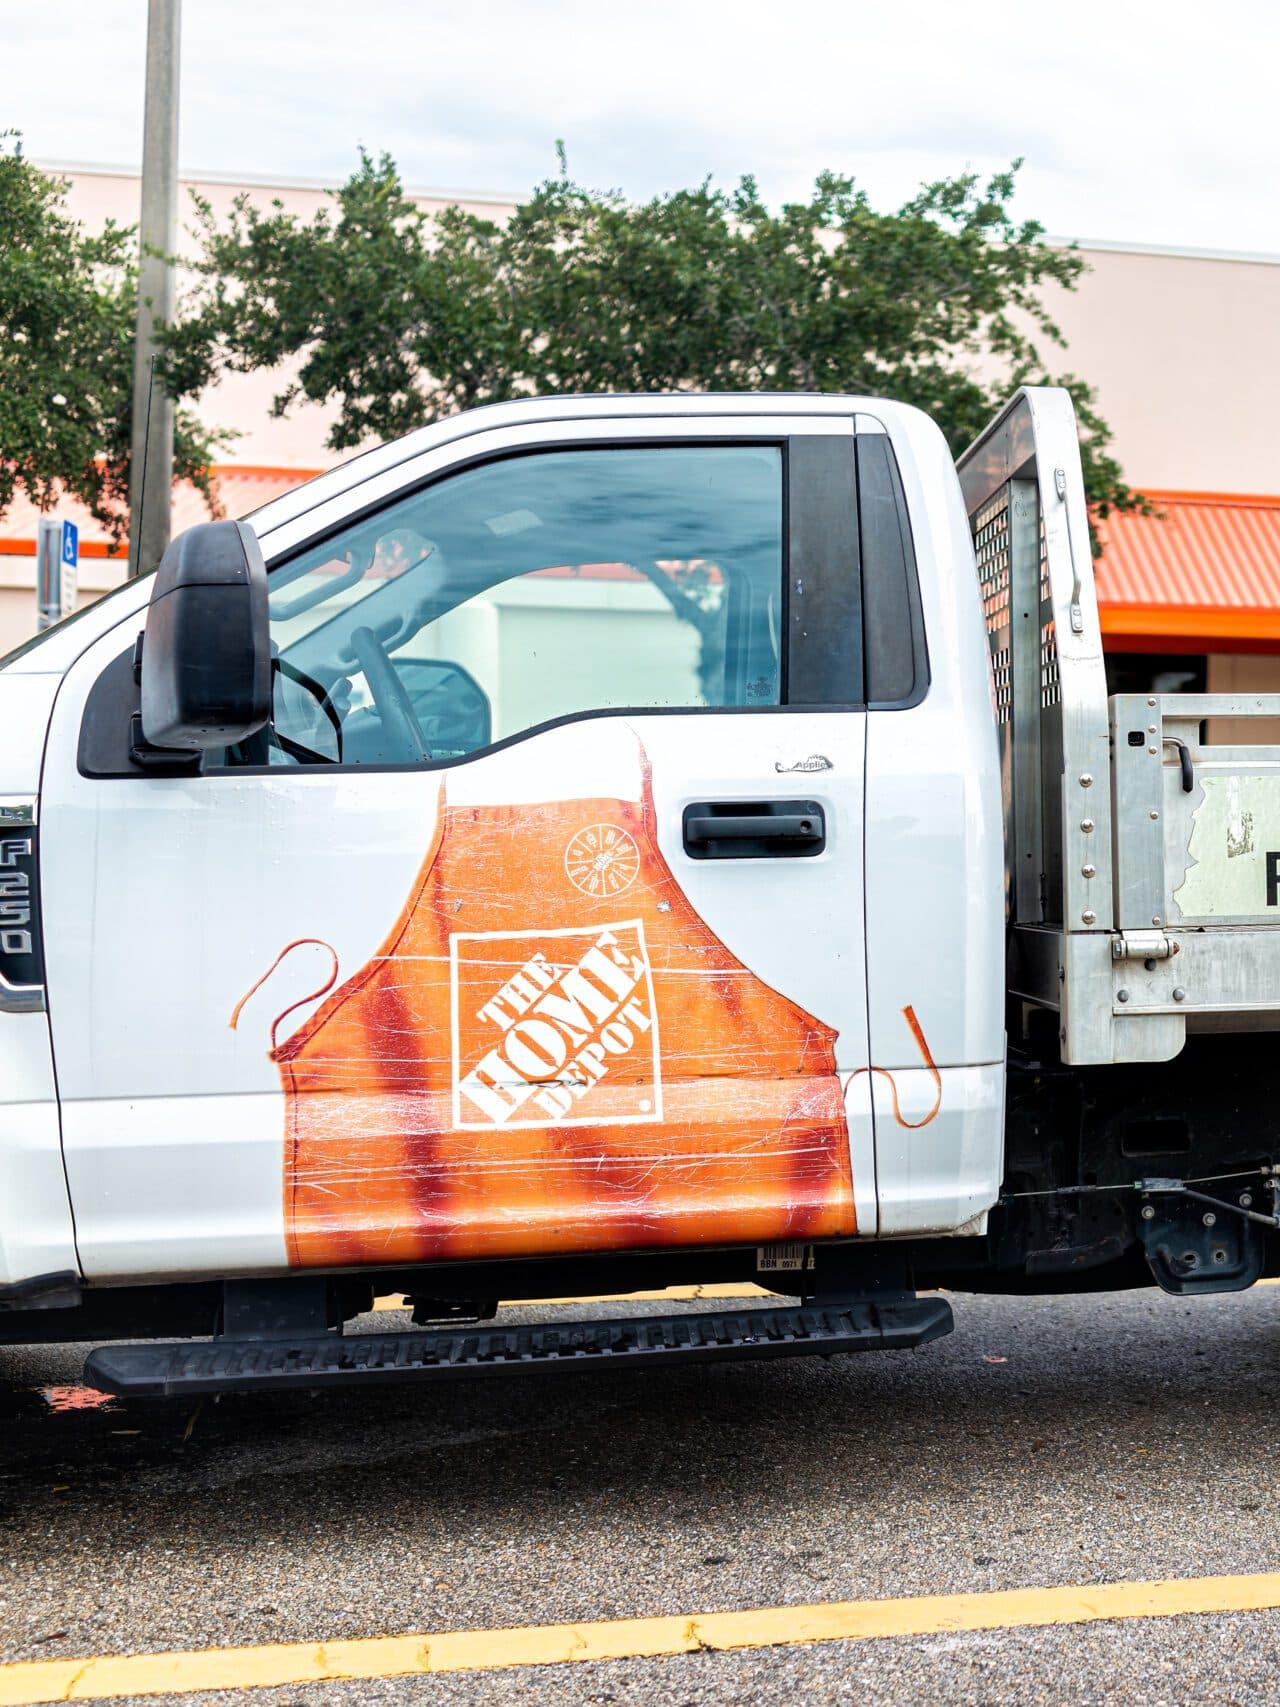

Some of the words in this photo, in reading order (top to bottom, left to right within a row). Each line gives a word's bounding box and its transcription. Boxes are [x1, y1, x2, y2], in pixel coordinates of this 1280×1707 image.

[459, 930, 647, 1122] HOME
[475, 952, 563, 1032] THE
[533, 996, 652, 1119] DEPOT
